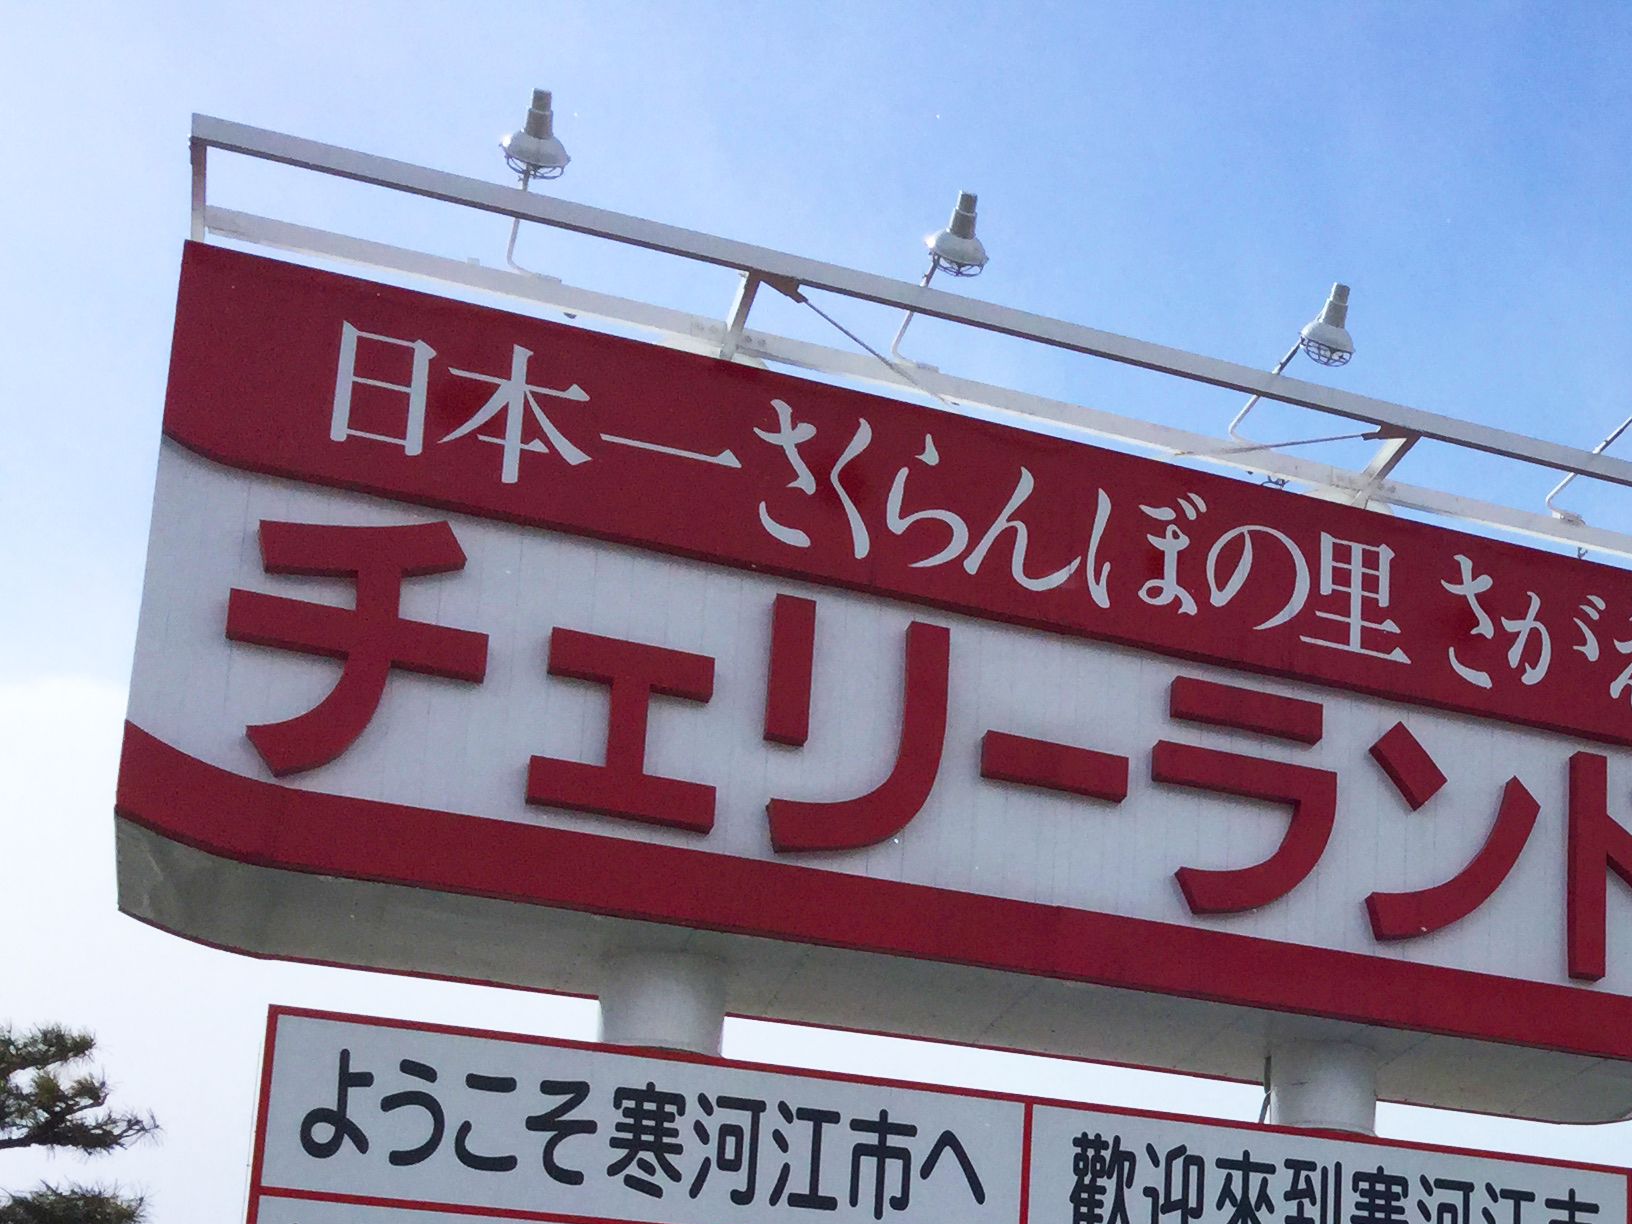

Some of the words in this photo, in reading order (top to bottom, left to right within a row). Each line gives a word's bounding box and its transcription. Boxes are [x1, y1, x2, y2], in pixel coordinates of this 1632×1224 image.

[330, 320, 1411, 664] 日本一さくらんぼの里
[298, 1047, 986, 1220] ようこそ寒河江市へ
